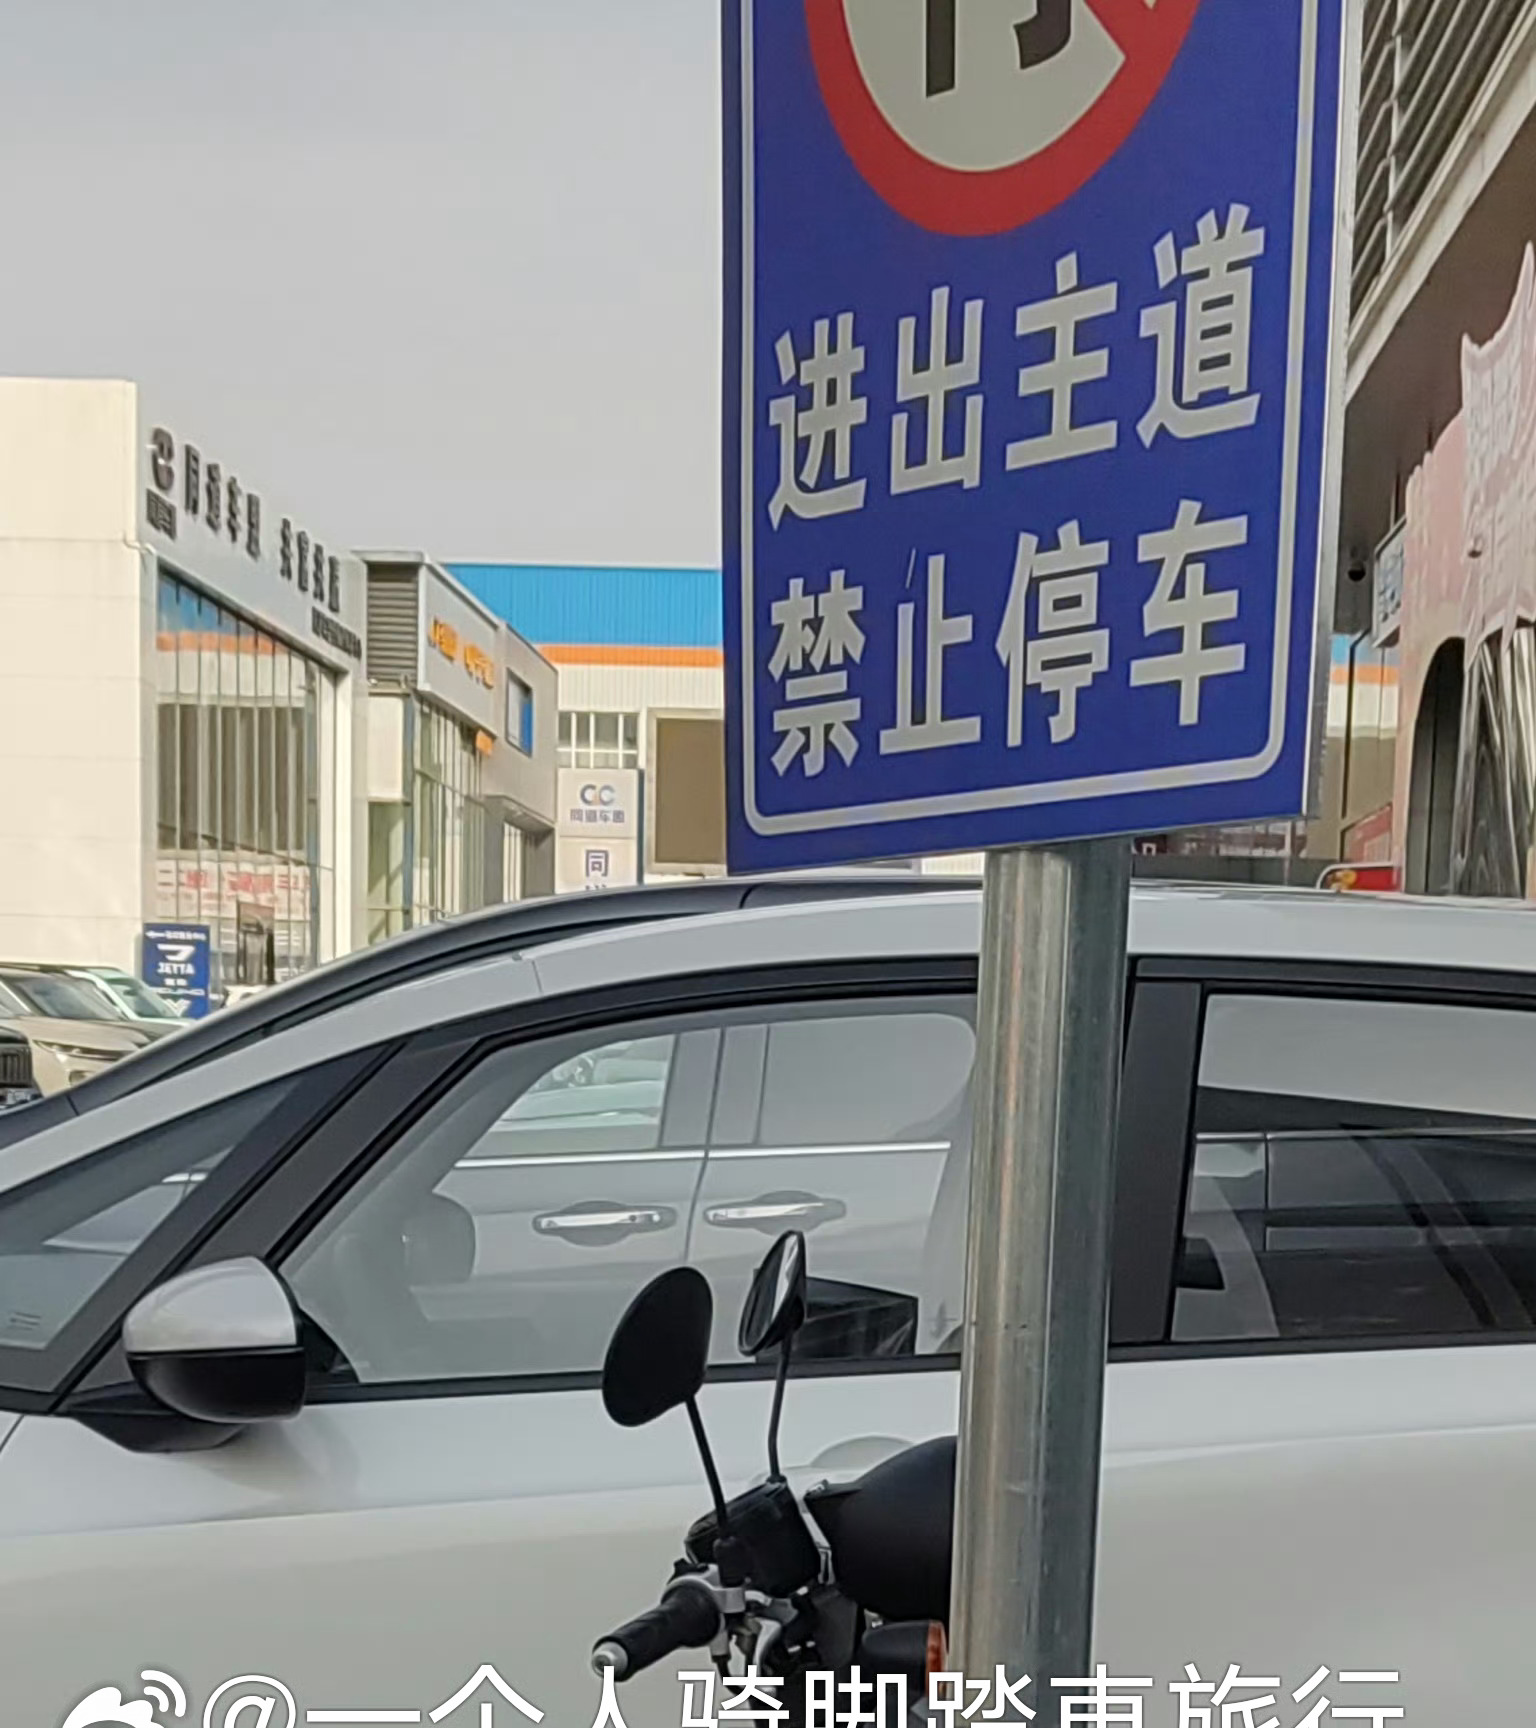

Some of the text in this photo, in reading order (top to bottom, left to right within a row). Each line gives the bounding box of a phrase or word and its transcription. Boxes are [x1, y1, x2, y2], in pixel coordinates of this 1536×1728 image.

[767, 202, 1266, 531] 进出主道
[767, 498, 1250, 778] 禁止停车
[156, 962, 195, 975] JETTA
